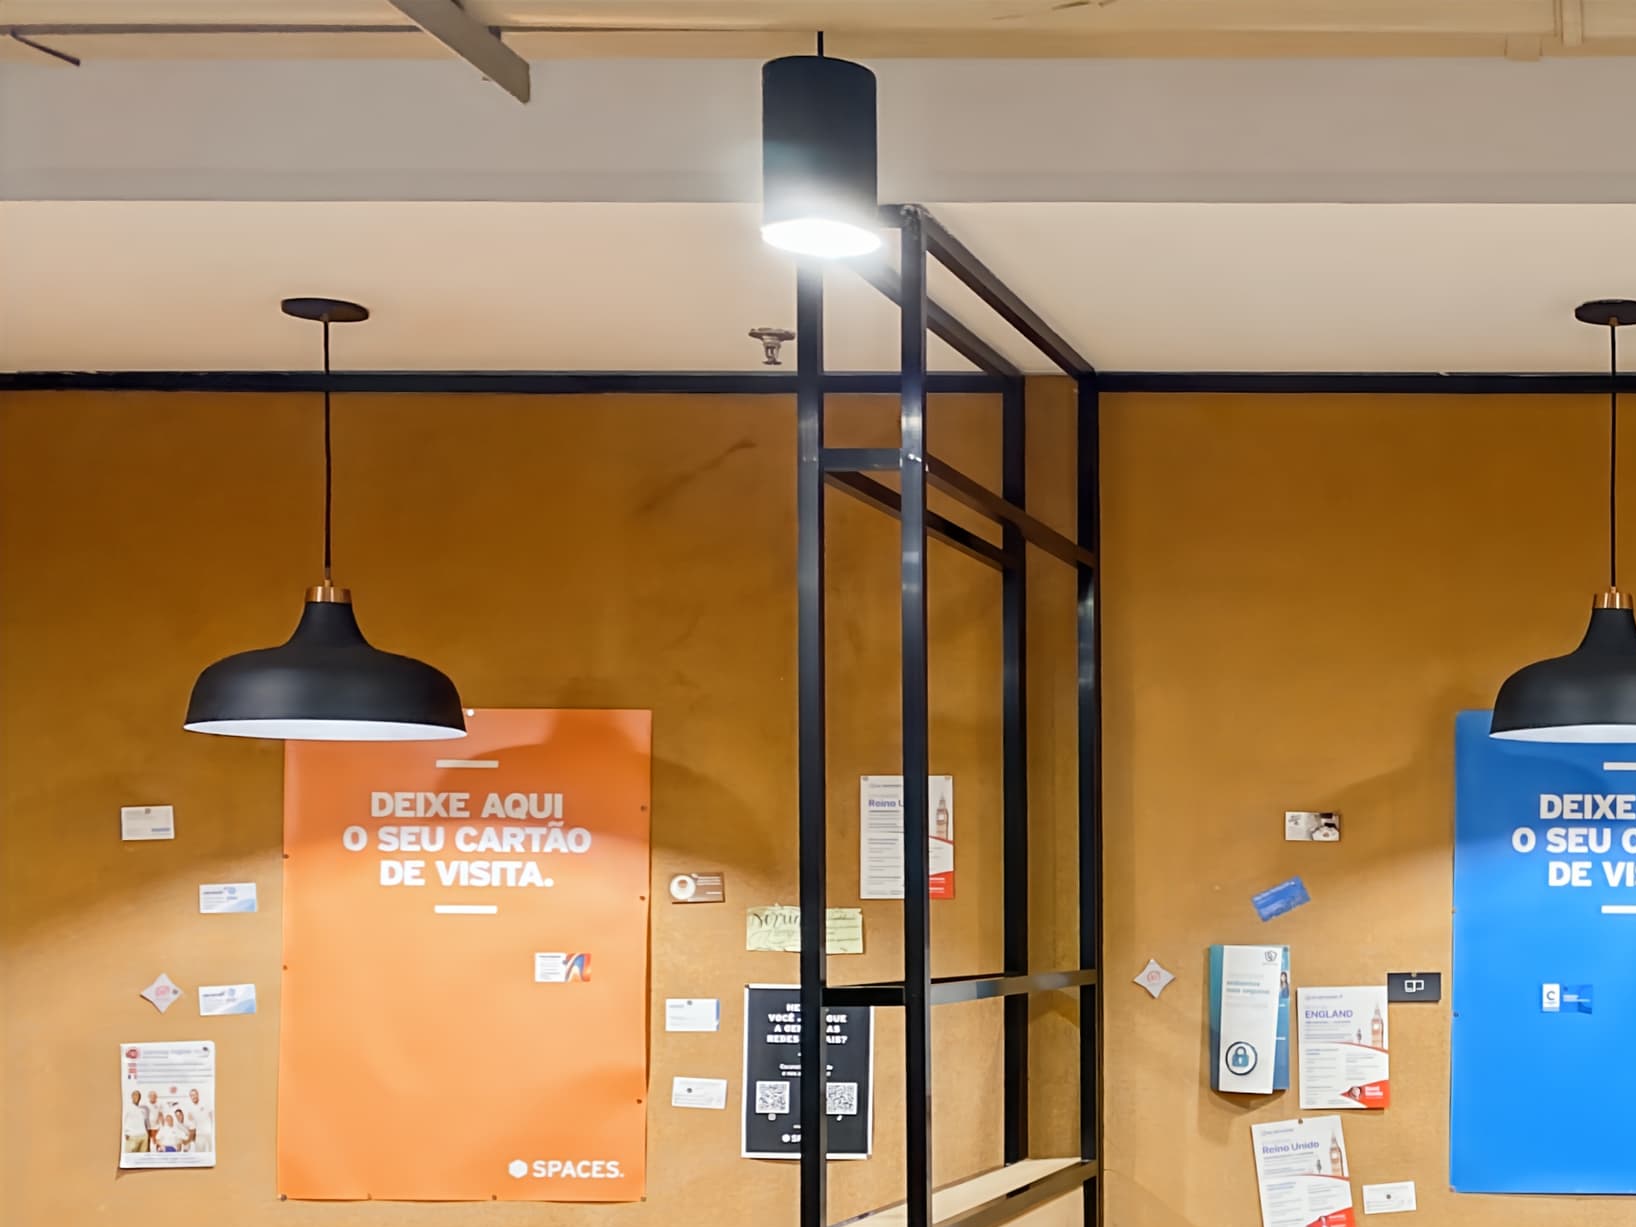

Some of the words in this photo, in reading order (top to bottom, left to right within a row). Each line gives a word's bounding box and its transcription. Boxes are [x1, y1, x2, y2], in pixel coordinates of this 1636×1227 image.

[371, 792, 470, 818] DEIXE
[480, 793, 563, 819] AQUI
[868, 800, 896, 808] Reino
[1540, 794, 1636, 820] DEIXE
[342, 826, 368, 852] O
[377, 826, 445, 852] SEU
[455, 821, 592, 854] CARTÃO
[1511, 827, 1537, 853] O
[1546, 827, 1612, 854] SEU
[380, 860, 425, 886] DE
[435, 860, 555, 887] VISITA.
[1548, 860, 1593, 887] DE
[1305, 1010, 1353, 1019] ENGLAND
[1262, 1145, 1289, 1154] Reino
[1291, 1140, 1320, 1151] Unido
[532, 1160, 625, 1179] SPACES.
